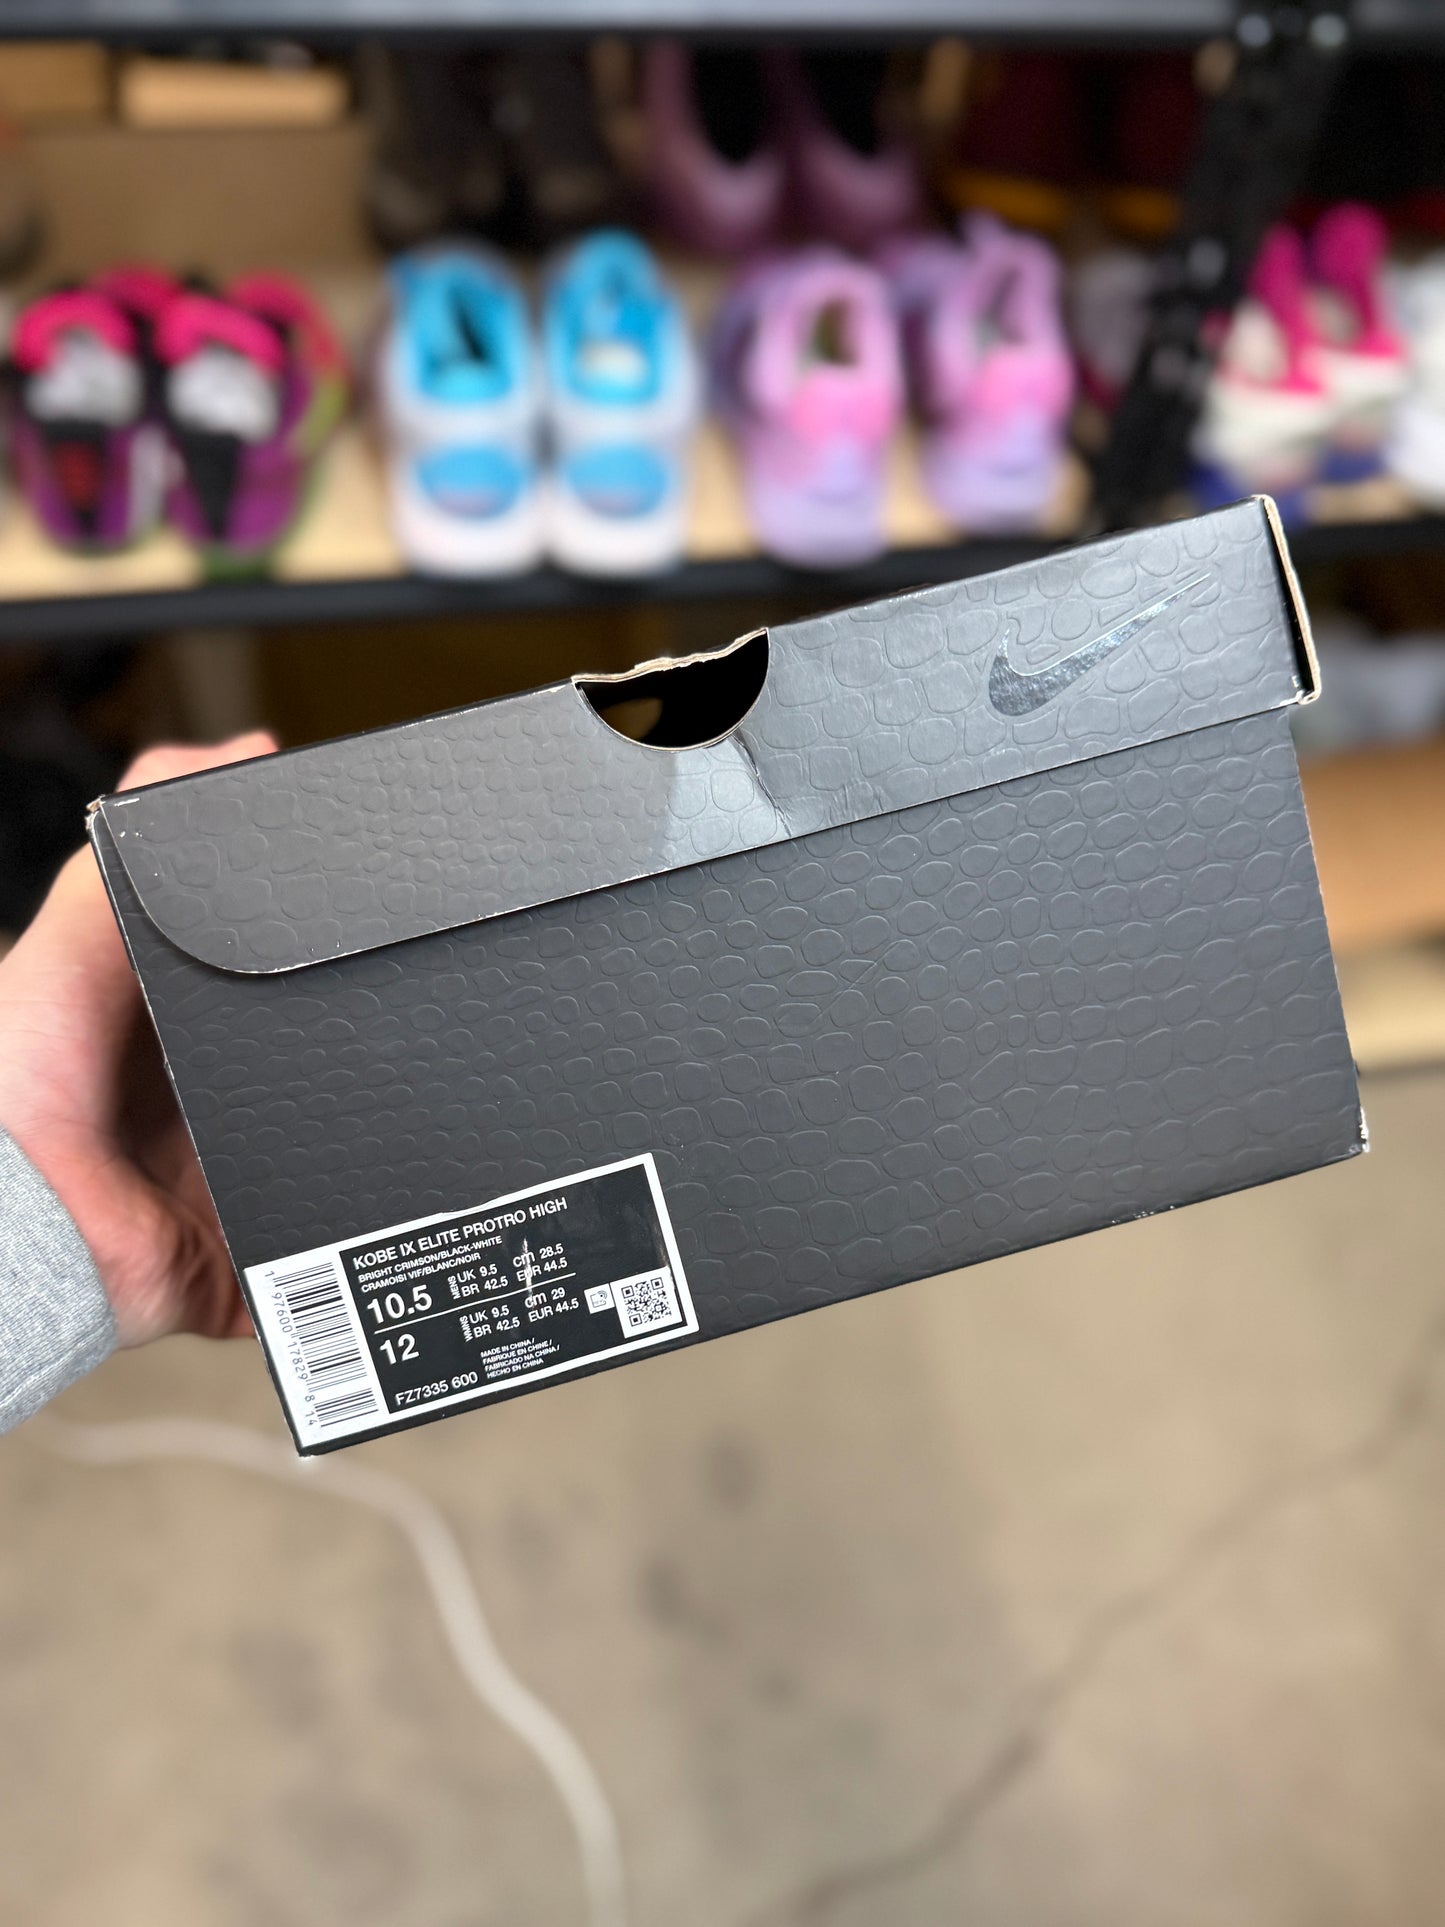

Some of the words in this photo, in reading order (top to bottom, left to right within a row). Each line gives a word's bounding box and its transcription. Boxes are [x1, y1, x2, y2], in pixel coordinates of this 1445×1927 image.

[353, 1246, 397, 1269] KOBE
[400, 1241, 416, 1257] IX
[418, 1229, 461, 1251] ELITE
[463, 1209, 527, 1239] PROTRO
[529, 1197, 568, 1219] HIGH
[358, 1267, 393, 1283] BRIGHT
[395, 1236, 502, 1273] CRIMSON/BLACK-WHITE
[361, 1274, 407, 1293] CRAMOISI
[409, 1253, 481, 1279] VIF/BLANC/NOIR
[457, 1269, 476, 1283] UK
[480, 1264, 497, 1277] 9.5
[513, 1251, 535, 1267] cm
[539, 1243, 564, 1259] 28.5
[461, 1284, 480, 1297] BR
[484, 1276, 508, 1291] 42.5
[517, 1266, 541, 1282] EUR
[544, 1257, 568, 1273] 44.5
[367, 1285, 432, 1324] 10.5
[448, 1276, 459, 1300] MENS
[469, 1310, 488, 1324] UK
[492, 1305, 510, 1318] 9.5
[524, 1291, 547, 1309] cm
[551, 1287, 565, 1299] 29
[459, 1316, 473, 1342] WMNS
[473, 1325, 492, 1338] BR
[496, 1318, 520, 1332] 42.5
[528, 1307, 554, 1323] EUR
[555, 1298, 579, 1313] 44.5
[380, 1333, 420, 1365] 12
[480, 1348, 501, 1358] MADE
[510, 1340, 531, 1350] CHINA
[482, 1350, 516, 1365] FABRIQUE
[517, 1347, 527, 1355] EN
[527, 1342, 549, 1353] CHINE
[485, 1357, 523, 1372] FABRICADO
[524, 1354, 535, 1362] NA
[535, 1347, 556, 1358] CHINA
[487, 1367, 511, 1379] HECHO
[512, 1364, 521, 1373] EN
[521, 1358, 544, 1371] CHINA
[395, 1380, 449, 1405] FZ7335
[452, 1372, 478, 1389] 600
